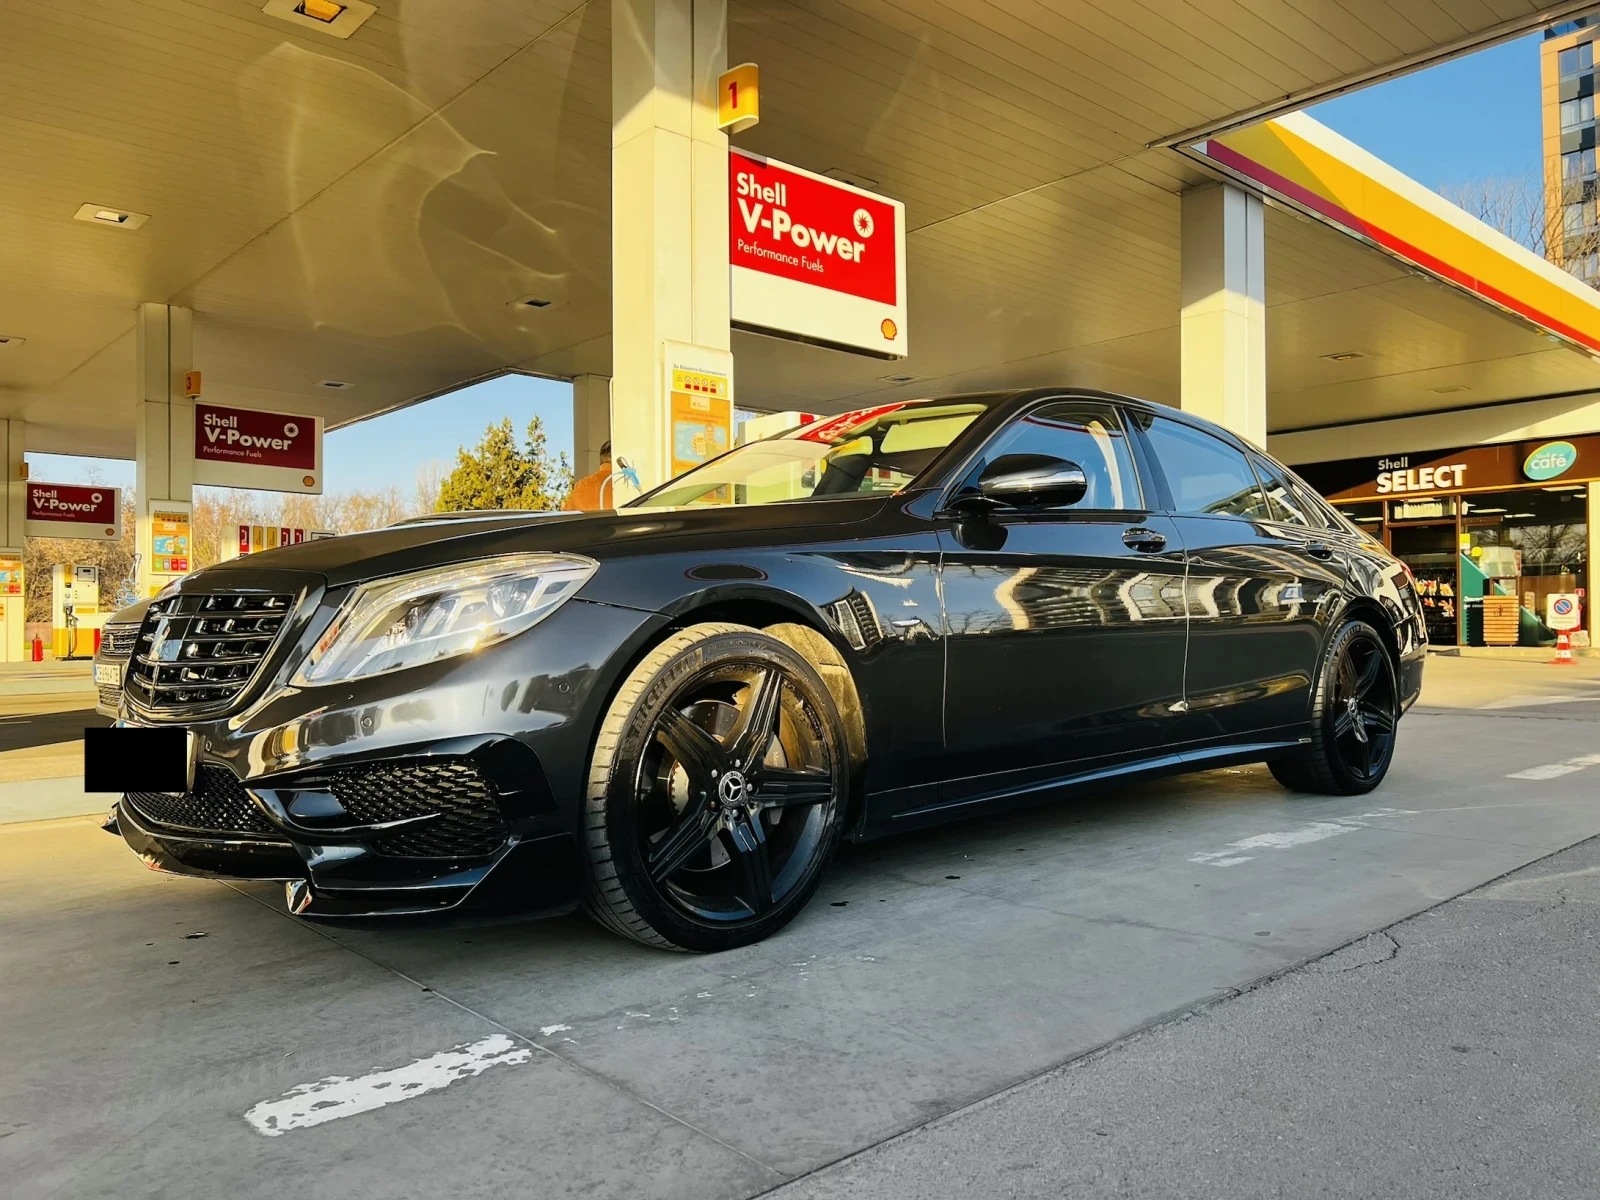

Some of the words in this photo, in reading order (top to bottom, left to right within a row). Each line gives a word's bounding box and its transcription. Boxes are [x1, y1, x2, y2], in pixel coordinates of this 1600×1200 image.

[728, 81, 738, 109] 1
[736, 172, 786, 207] Shell
[737, 197, 865, 263] V-Power
[737, 239, 799, 267] Performance
[801, 255, 824, 273] Fuels
[186, 376, 192, 390] 3
[204, 413, 237, 428] Shell
[204, 426, 292, 450] V-Power
[203, 445, 245, 457] Performance
[246, 450, 262, 458] Fuels
[1531, 453, 1567, 470] café
[1378, 456, 1408, 470] Shell
[1376, 463, 1467, 494] SELECT
[32, 489, 57, 498] Shell
[33, 498, 97, 512] V-Power
[632, 651, 699, 731] MICHELIN
